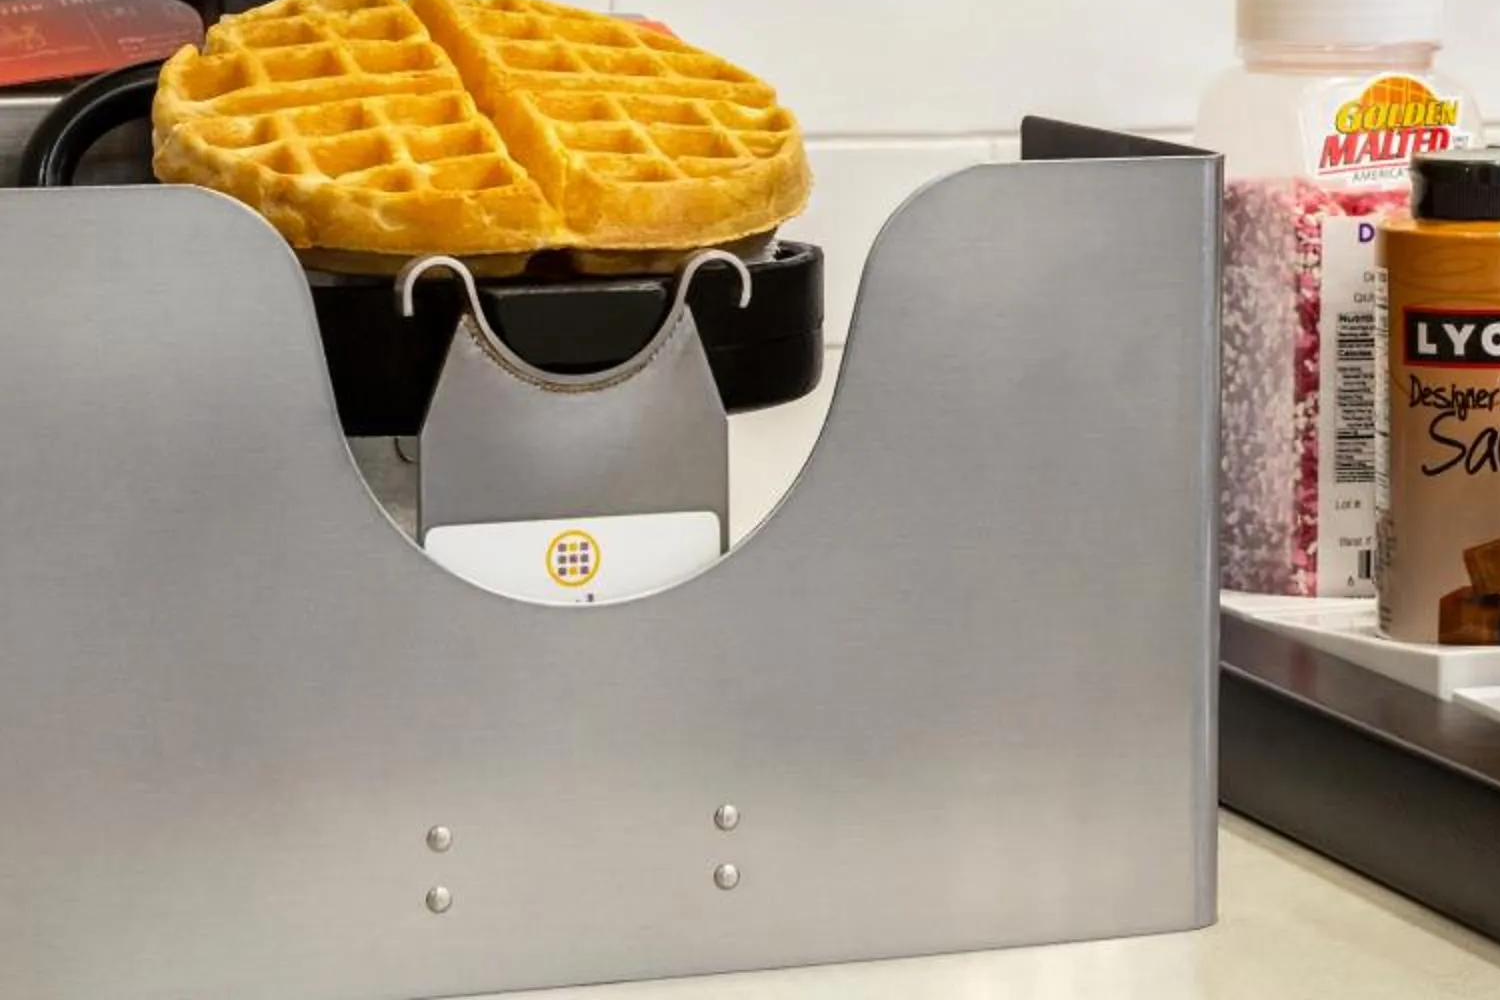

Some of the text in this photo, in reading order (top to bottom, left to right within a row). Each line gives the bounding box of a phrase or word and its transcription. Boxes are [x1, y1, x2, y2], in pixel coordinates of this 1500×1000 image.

[1336, 99, 1460, 134] GOLDEN
[1318, 126, 1450, 169] MALTED
[1409, 374, 1499, 421] Designer
